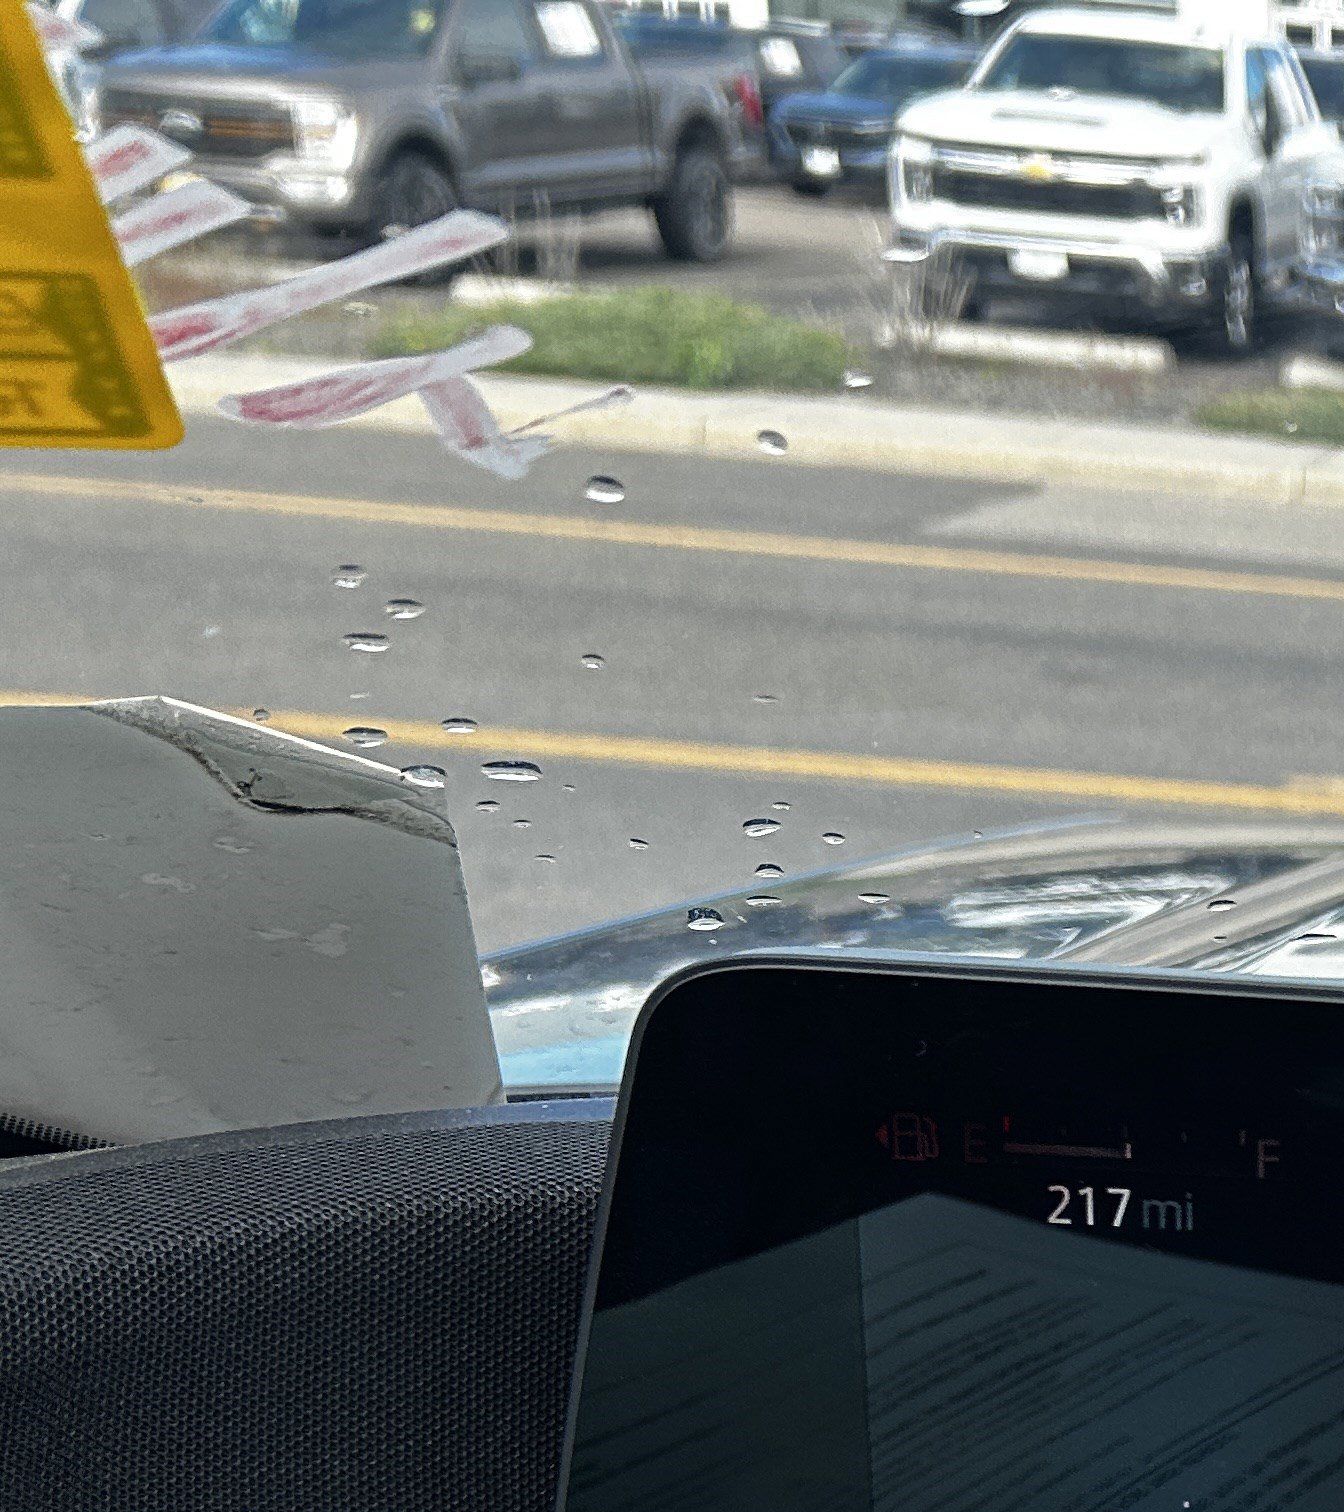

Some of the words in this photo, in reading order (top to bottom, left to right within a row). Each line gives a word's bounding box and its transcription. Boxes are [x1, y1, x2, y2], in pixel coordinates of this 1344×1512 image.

[1255, 1138, 1281, 1180] F
[1046, 1183, 1133, 1228] 217
[1141, 1192, 1195, 1232] mi
